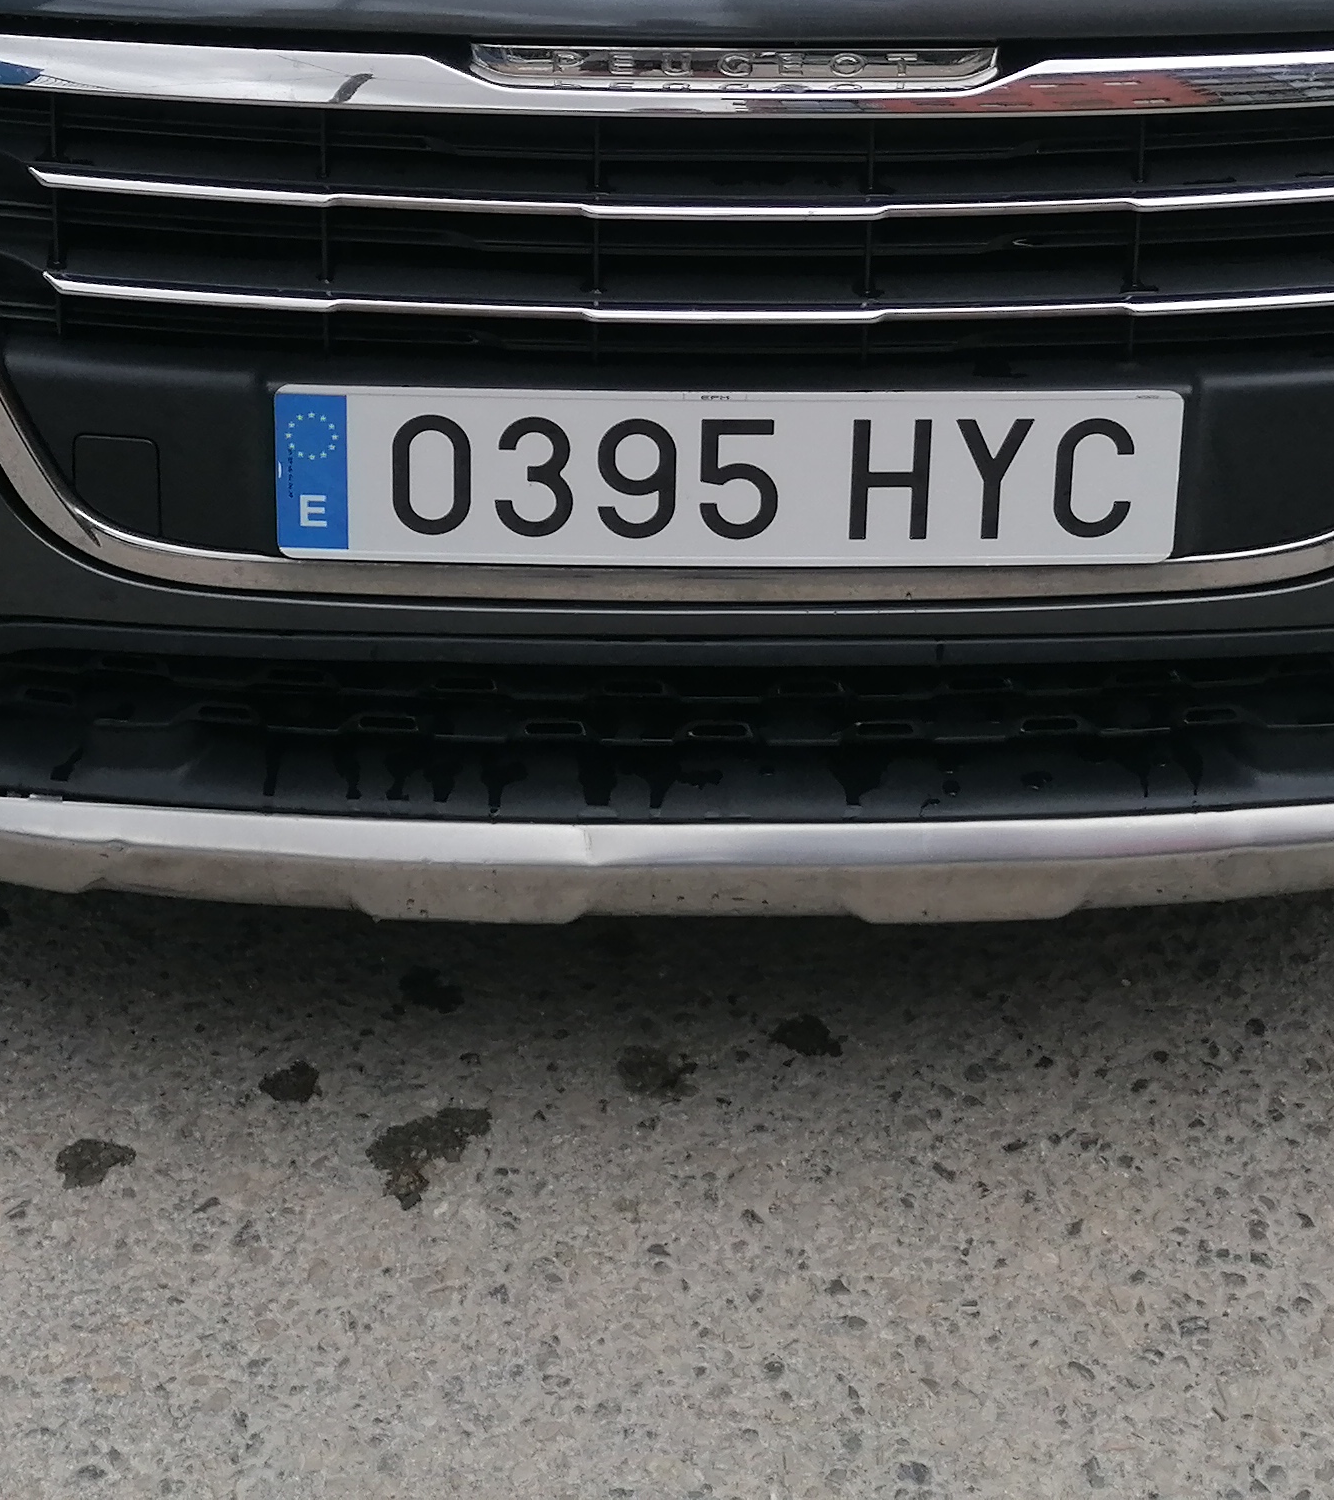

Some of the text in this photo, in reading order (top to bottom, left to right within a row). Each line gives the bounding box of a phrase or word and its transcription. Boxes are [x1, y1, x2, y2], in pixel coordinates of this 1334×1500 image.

[552, 51, 919, 77] PEUGEOT
[299, 494, 328, 528] E
[390, 414, 780, 541] 0395
[849, 416, 1136, 542] HYC
